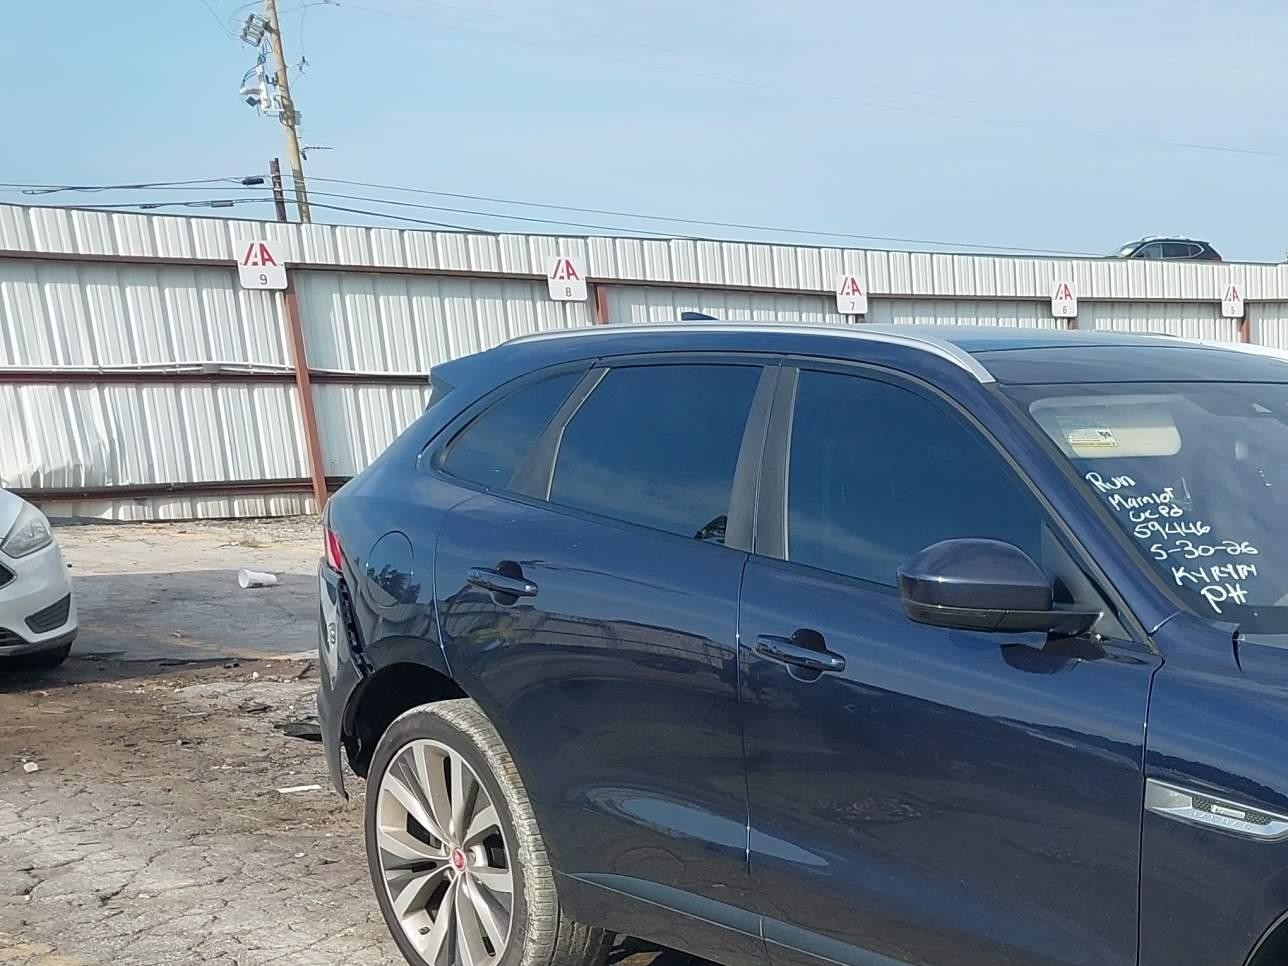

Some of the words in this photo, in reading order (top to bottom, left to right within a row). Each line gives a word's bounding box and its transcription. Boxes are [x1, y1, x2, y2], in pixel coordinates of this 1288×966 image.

[259, 274, 268, 286] 9
[565, 287, 572, 297] 8
[849, 301, 855, 311] 7
[1062, 305, 1068, 314] 6
[1230, 305, 1236, 315] 5
[1150, 540, 1259, 560] 5-30-26
